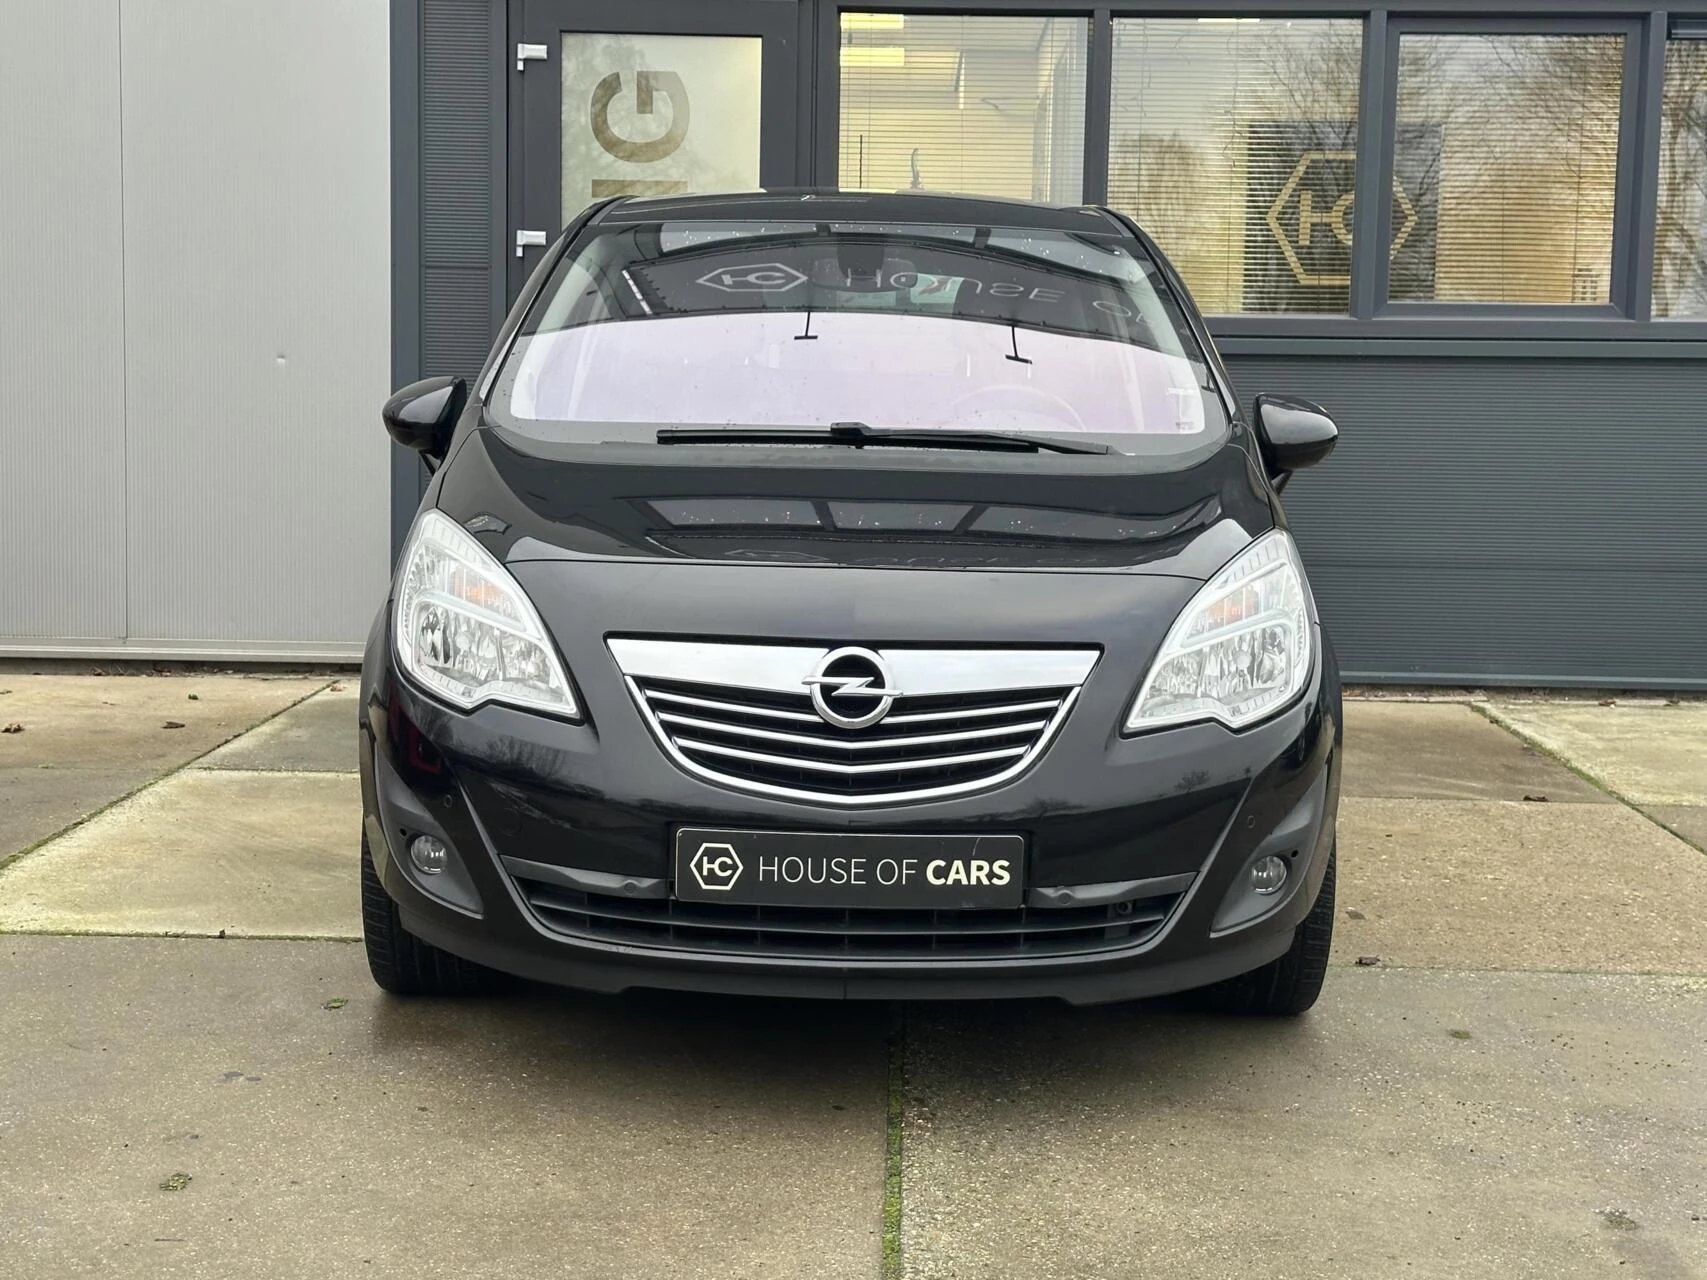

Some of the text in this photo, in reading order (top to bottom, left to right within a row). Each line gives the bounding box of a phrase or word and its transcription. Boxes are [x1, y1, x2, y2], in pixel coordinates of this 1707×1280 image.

[759, 856, 866, 885] HOUSE
[876, 859, 917, 885] OF
[926, 859, 1011, 885] CARS
